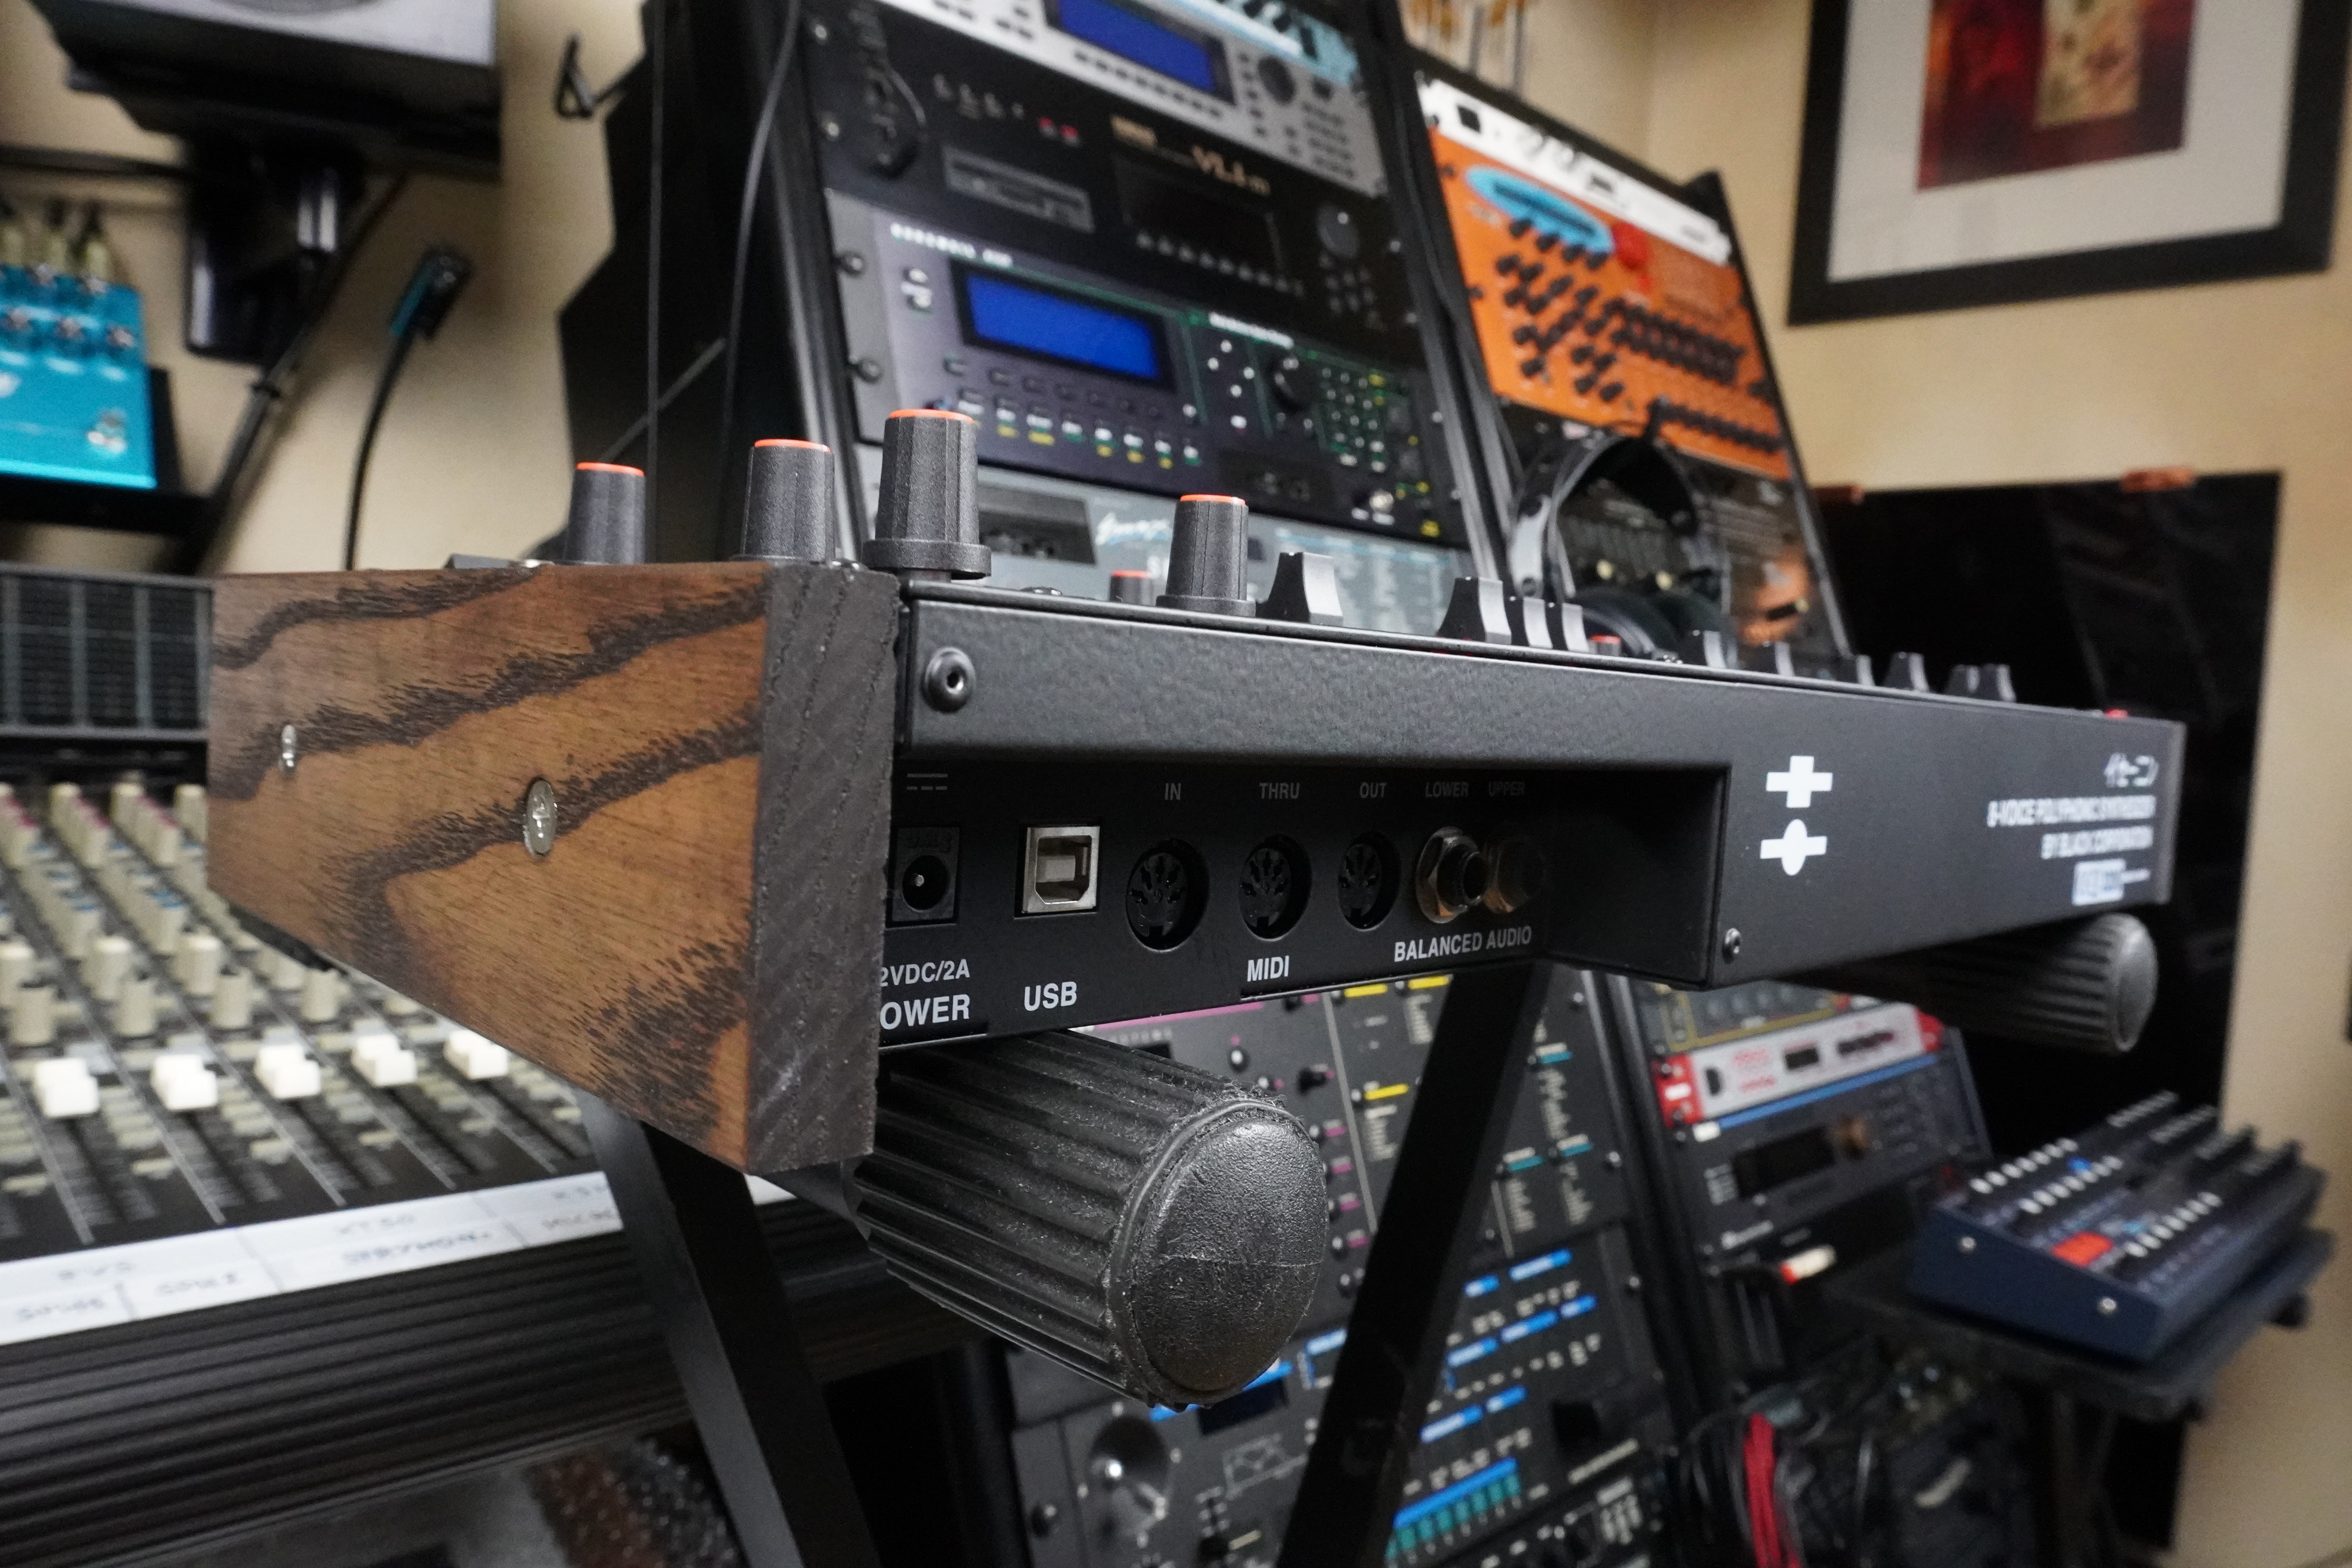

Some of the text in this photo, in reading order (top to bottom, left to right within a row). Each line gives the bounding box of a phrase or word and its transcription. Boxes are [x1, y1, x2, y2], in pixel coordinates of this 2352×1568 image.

[1165, 783, 1181, 800] IN
[1259, 782, 1299, 799] THRU
[1359, 782, 1386, 799] OUT
[1425, 781, 1469, 797] LOWER
[1488, 781, 1525, 796] UPPER
[1394, 926, 1532, 962] BALANCED AUDIO
[880, 958, 971, 987] 2VDC/2A
[1247, 955, 1290, 982] MIDI
[1024, 981, 1077, 1011] USB
[880, 994, 970, 1030] OWER
